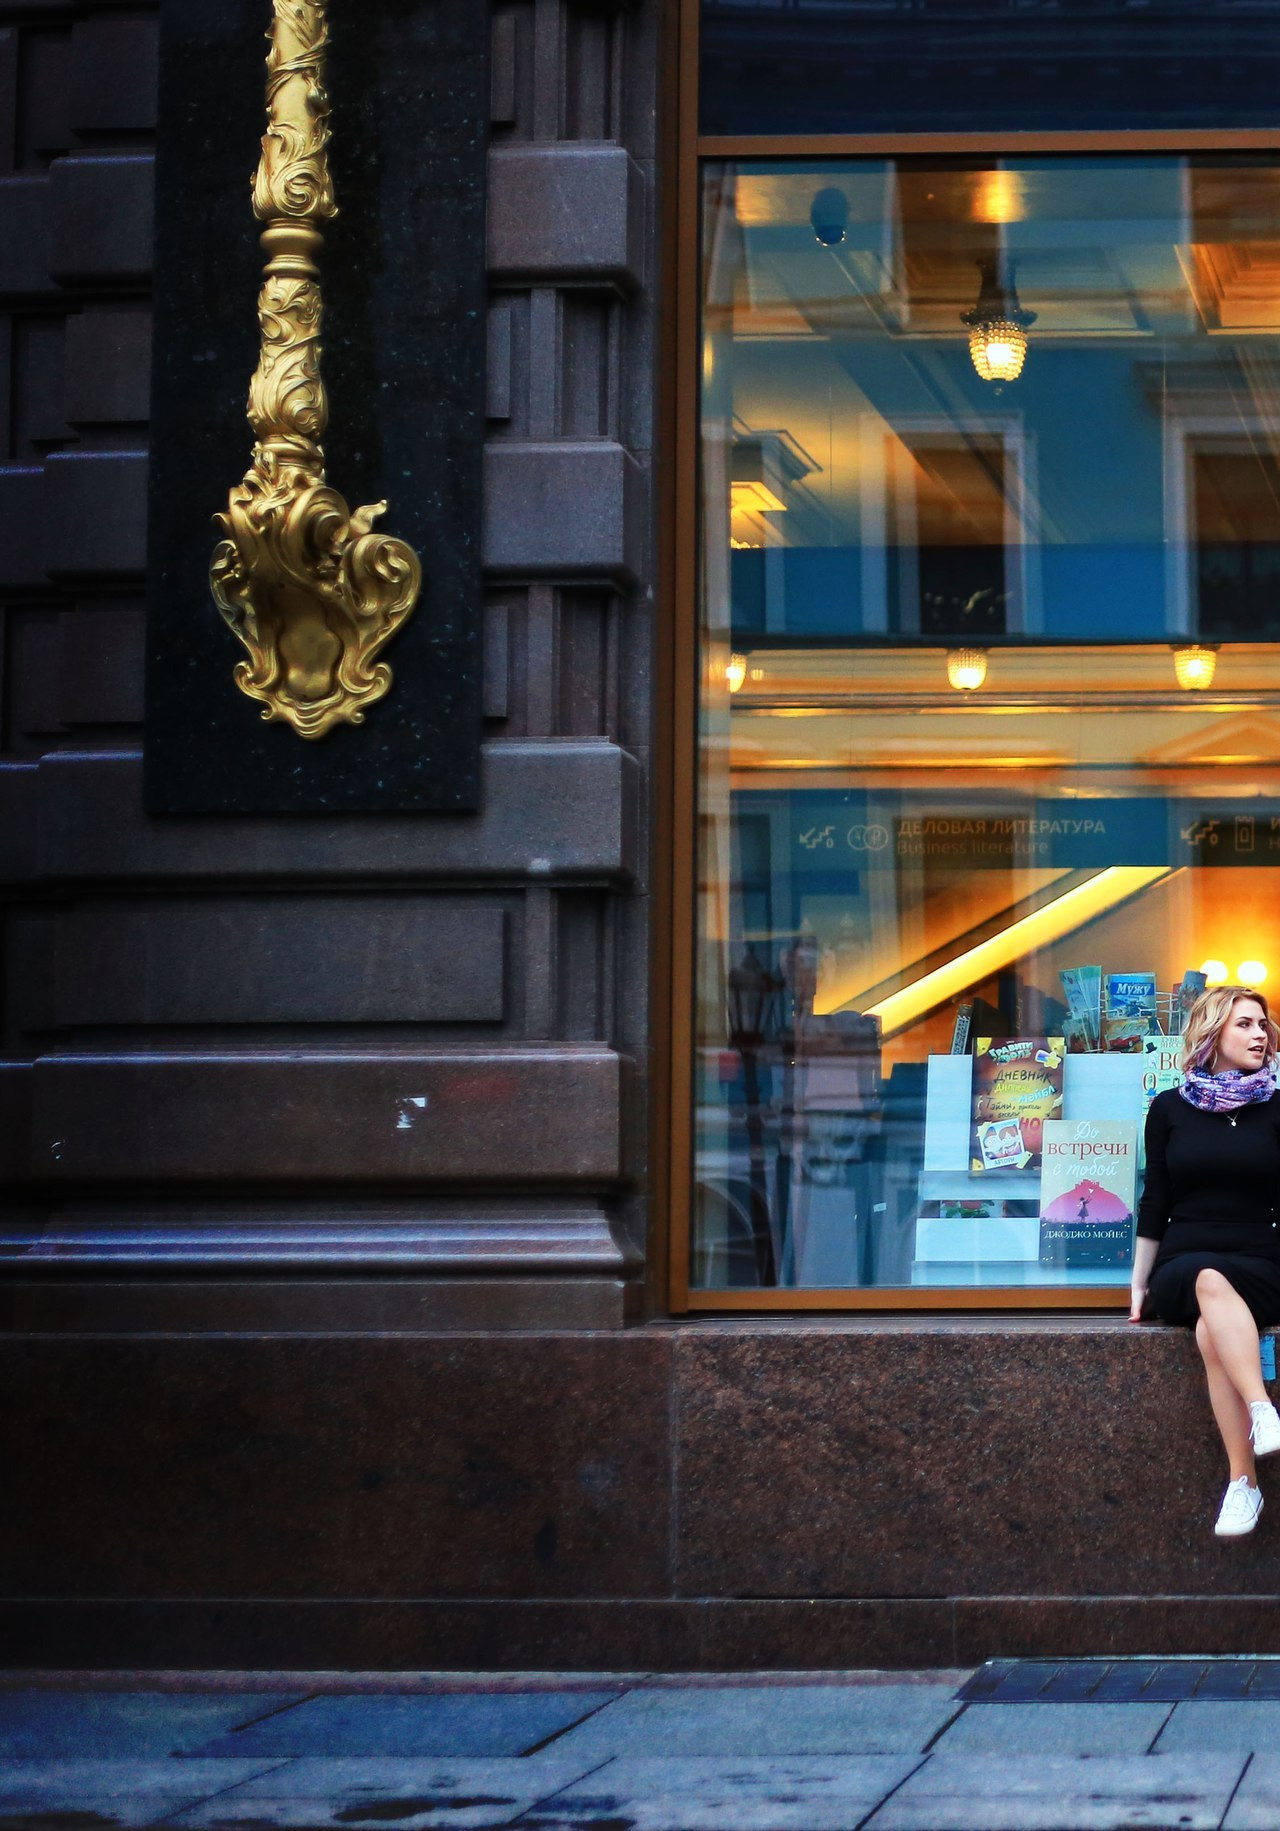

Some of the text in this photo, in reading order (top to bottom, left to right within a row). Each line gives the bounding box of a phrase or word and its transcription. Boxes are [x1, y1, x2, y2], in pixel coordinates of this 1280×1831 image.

[898, 819, 1106, 837] ДЕЛОВАЯ ЛИТЕРАТУРА
[897, 840, 1049, 855] Business literature
[1116, 983, 1151, 996] Мужу
[994, 1069, 1053, 1084] ДНЕВНИК
[1073, 1121, 1099, 1141] До
[1048, 1142, 1128, 1160] встречи
[1066, 1154, 1120, 1177] тобой
[1043, 1230, 1128, 1239] ДЖОДЖО МОЙЕС
